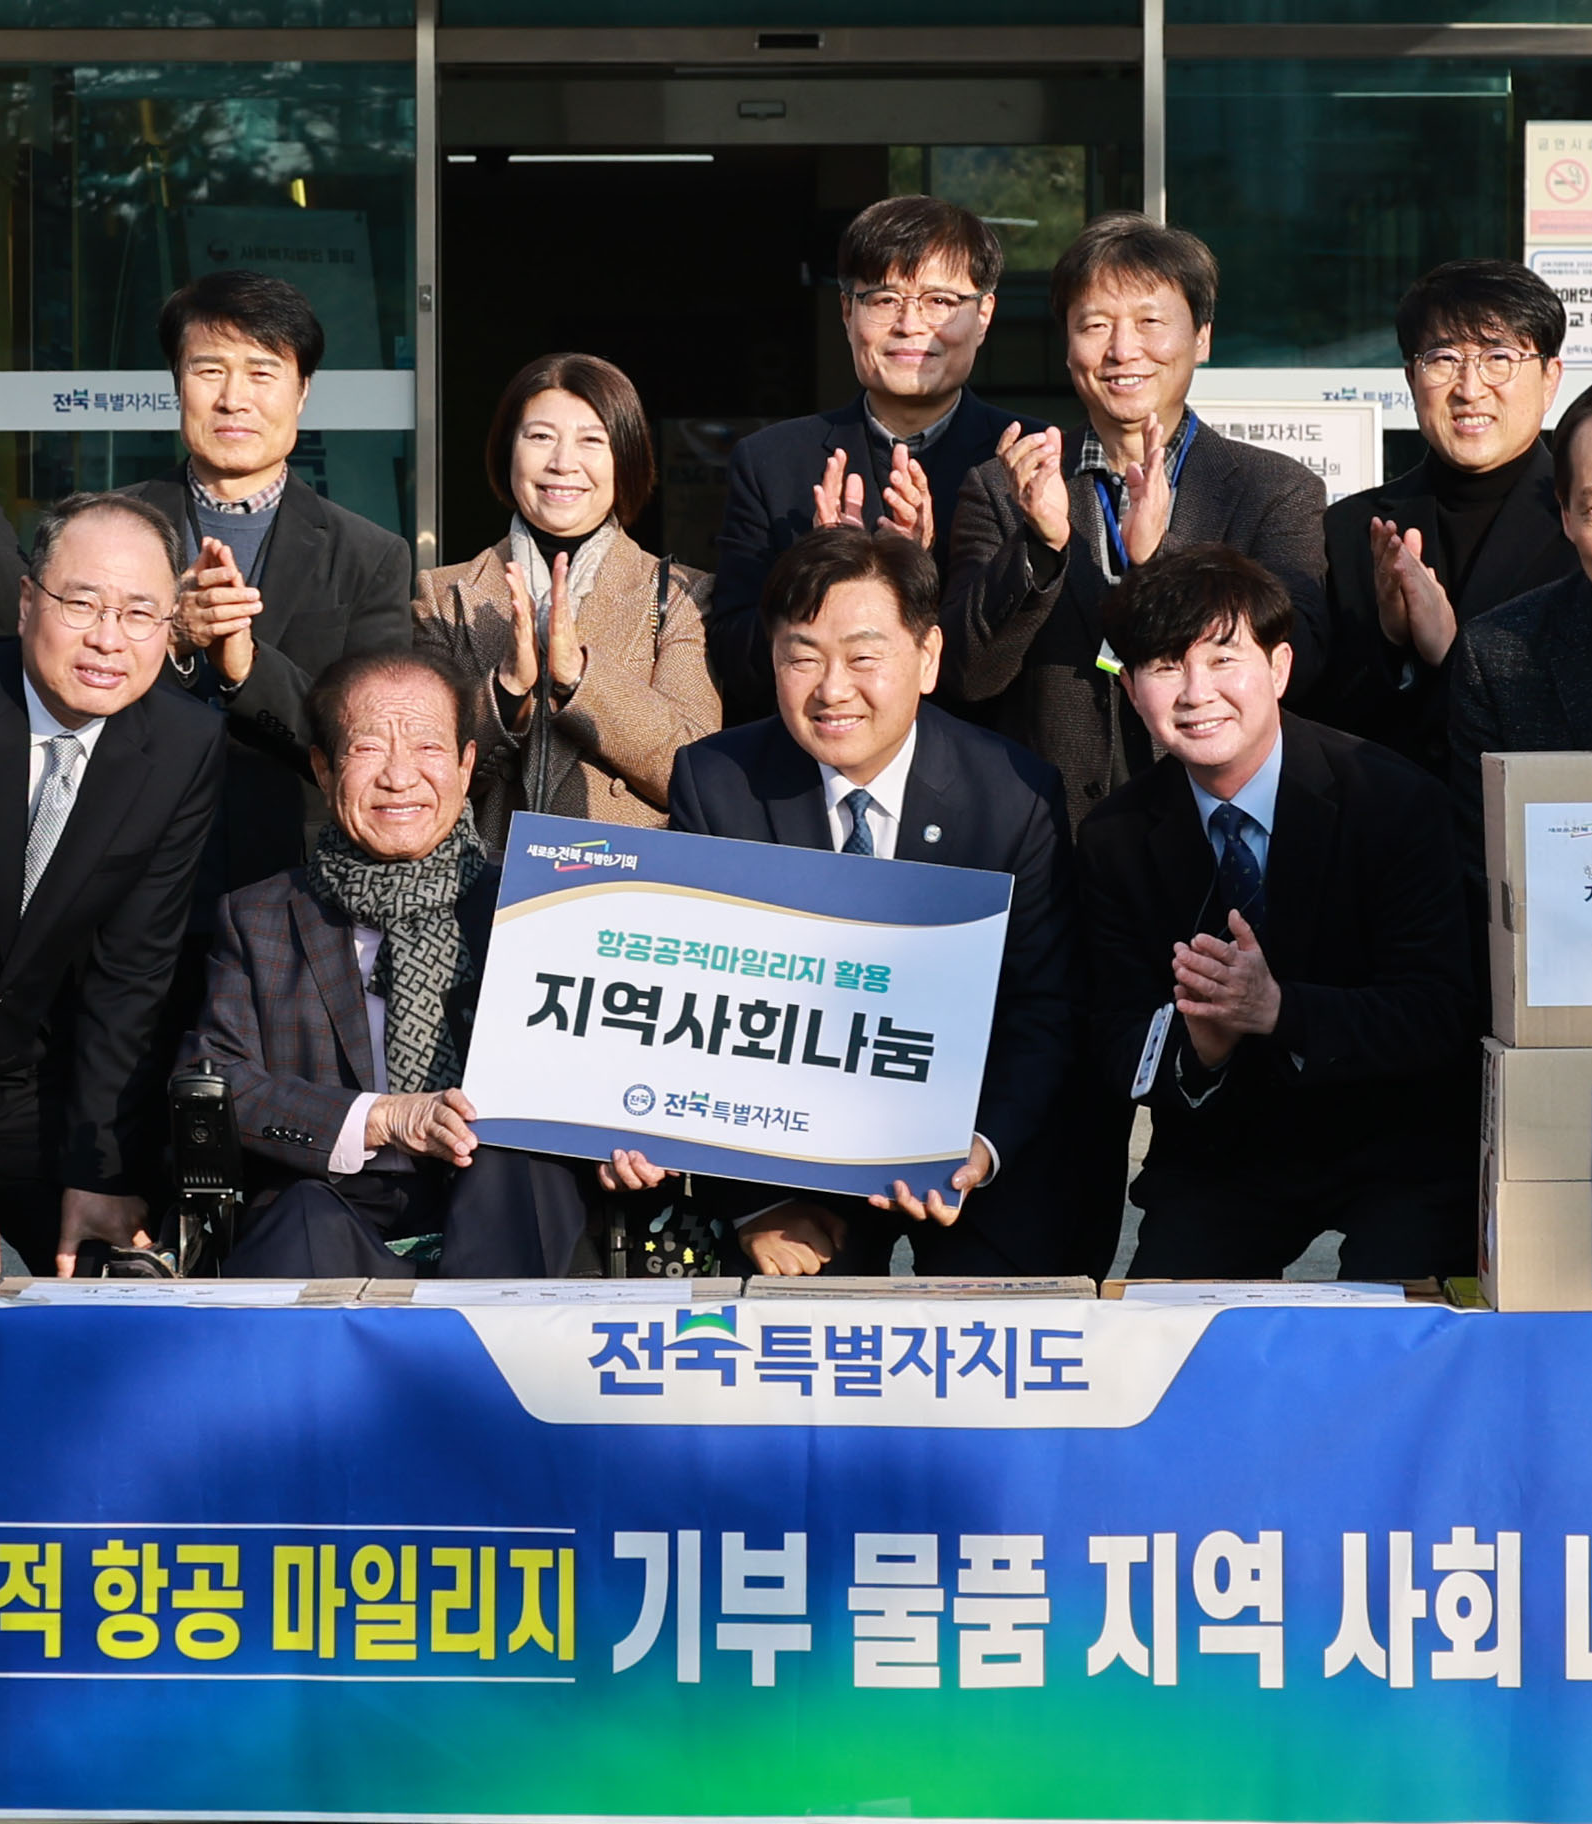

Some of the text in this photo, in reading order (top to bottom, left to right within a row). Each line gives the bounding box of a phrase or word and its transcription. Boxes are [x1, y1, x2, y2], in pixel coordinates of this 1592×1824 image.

[596, 929, 893, 993] 항공공적마일리지 활용
[525, 972, 935, 1083] 지역사회나눔
[91, 1539, 245, 1661] 항공
[272, 1543, 576, 1661] 마일리지
[612, 1529, 812, 1687] 기부
[848, 1531, 1051, 1689] 물품
[1086, 1529, 1286, 1689] 지역
[1323, 1526, 1523, 1689] 사회
